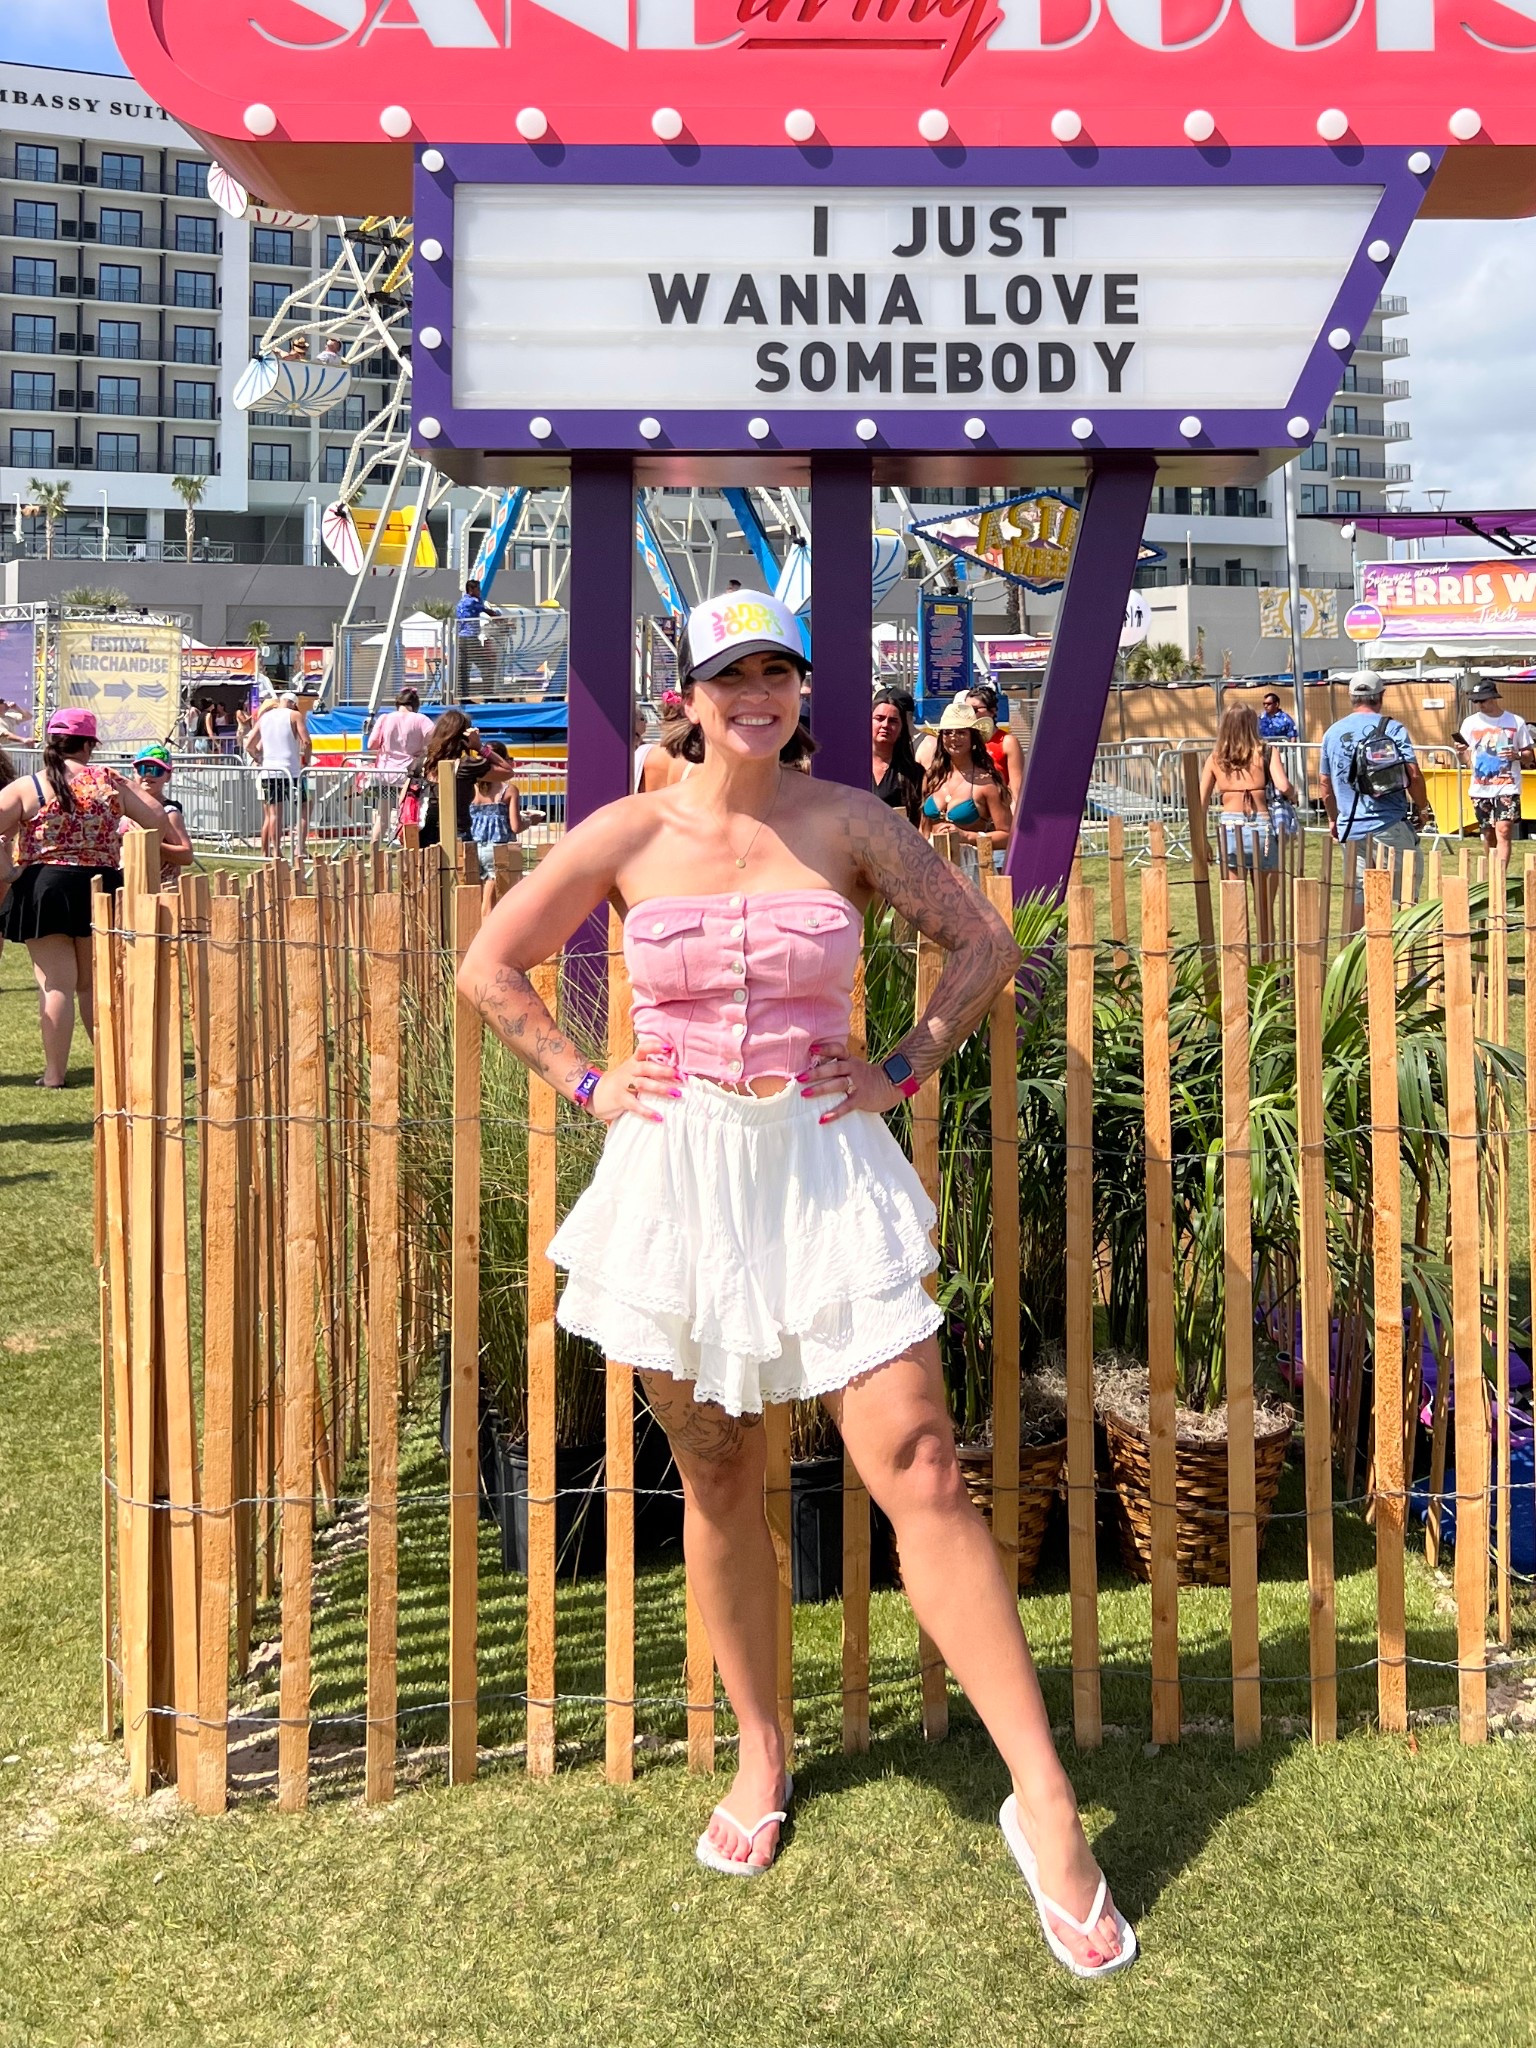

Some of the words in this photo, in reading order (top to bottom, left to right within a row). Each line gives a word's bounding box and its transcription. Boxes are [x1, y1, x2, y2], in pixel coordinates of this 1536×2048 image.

[110, 101, 170, 121] SUIT
[813, 206, 828, 257] I
[892, 206, 1067, 257] JUST
[648, 273, 923, 325] WANNA
[964, 273, 1139, 325] LOVE
[755, 341, 1135, 394] SOMEBODY
[1413, 562, 1450, 578] around
[1377, 573, 1495, 607] FERRIS
[1473, 603, 1519, 624] Tickets
[91, 635, 150, 653] FESTIVAL
[70, 654, 170, 674] MERCHANDISE
